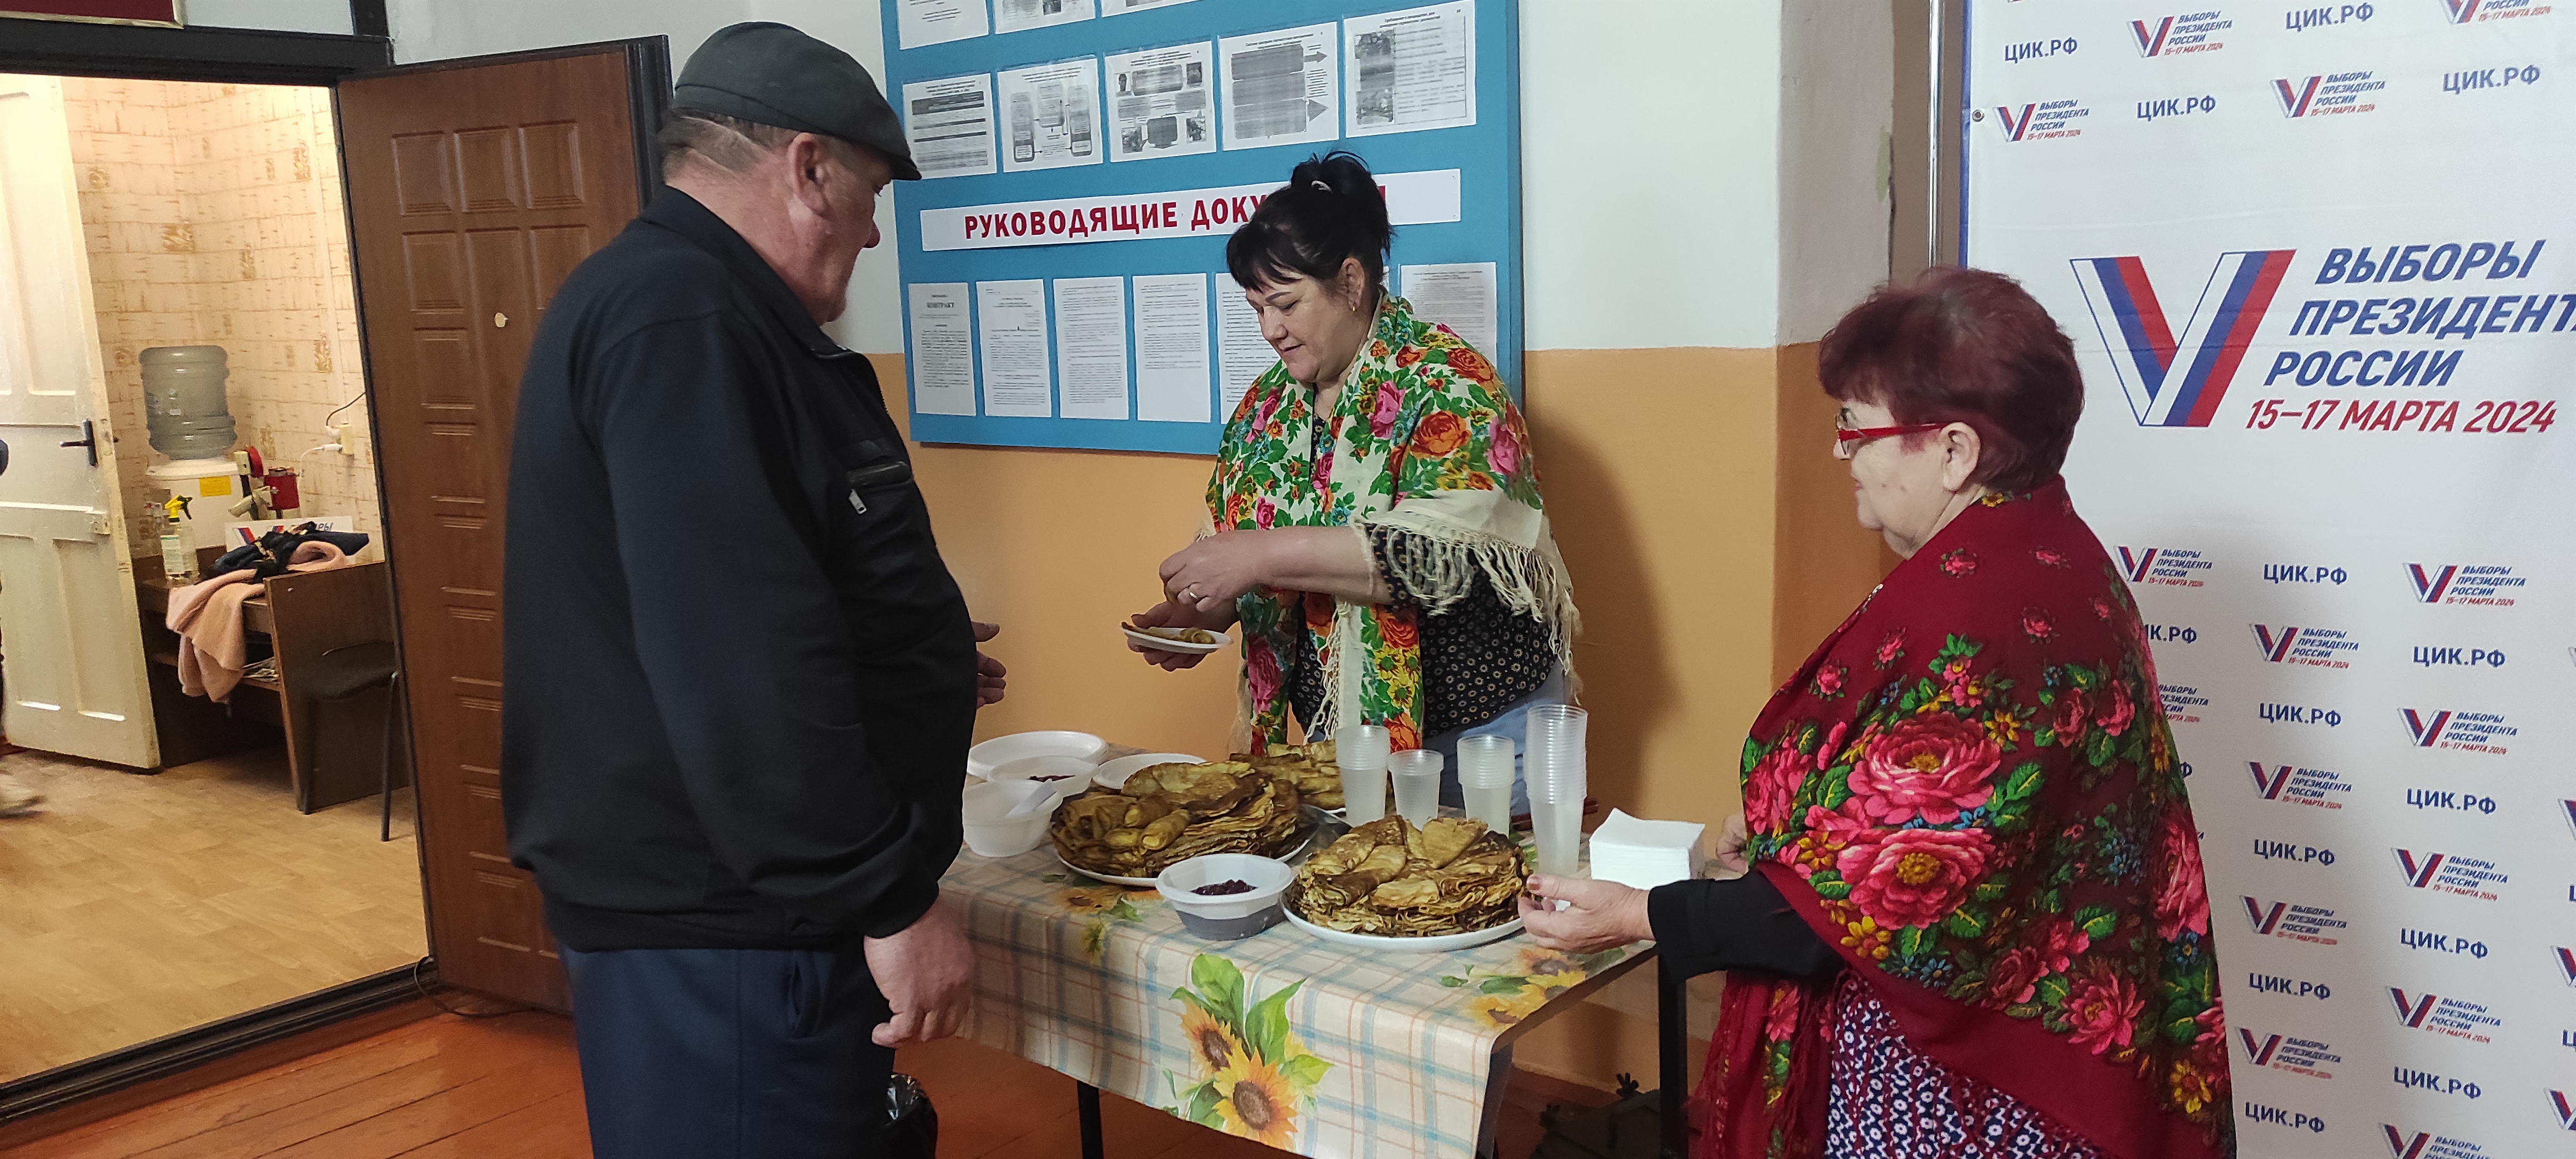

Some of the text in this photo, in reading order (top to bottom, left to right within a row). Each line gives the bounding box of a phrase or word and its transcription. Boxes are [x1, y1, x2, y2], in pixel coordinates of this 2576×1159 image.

[2286, 2, 2373, 33] ЦИК.РФ
[2005, 37, 2077, 64] ЦИК.РФ
[2168, 34, 2206, 46] РОССИИ
[2443, 64, 2540, 95] ЦИК.РФ
[2137, 95, 2216, 122] ЦИК.РФ
[966, 202, 1177, 238] РУКОВОДЯЩИЕ
[2315, 239, 2547, 284] ВЫБОРЫ
[2290, 294, 2576, 338] ПРЕЗИДЕНТ
[2263, 349, 2463, 387] РОССИИ
[2338, 401, 2459, 433] МАРТА
[2463, 400, 2555, 433] 2024
[2263, 563, 2347, 586] ЦИК.РФ
[2456, 577, 2525, 587] ПРЕЗИДЕНТА
[2462, 566, 2512, 575] ВЫБОРЫ
[2450, 587, 2495, 596] РОССИИ
[2292, 648, 2333, 658] РОССИИ
[2413, 646, 2505, 668] ЦИК.РФ
[2260, 702, 2341, 727] ЦИК.РФ
[2407, 788, 2496, 815] ЦИК.РФ
[2254, 839, 2335, 866] ЦИК.РФ
[2401, 928, 2488, 959] ЦИК.РФ
[2249, 972, 2331, 1000] ЦИК.РФ
[2394, 1066, 2481, 1099] ЦИК.РФ
[2245, 1102, 2325, 1133] ЦИК.РФ
